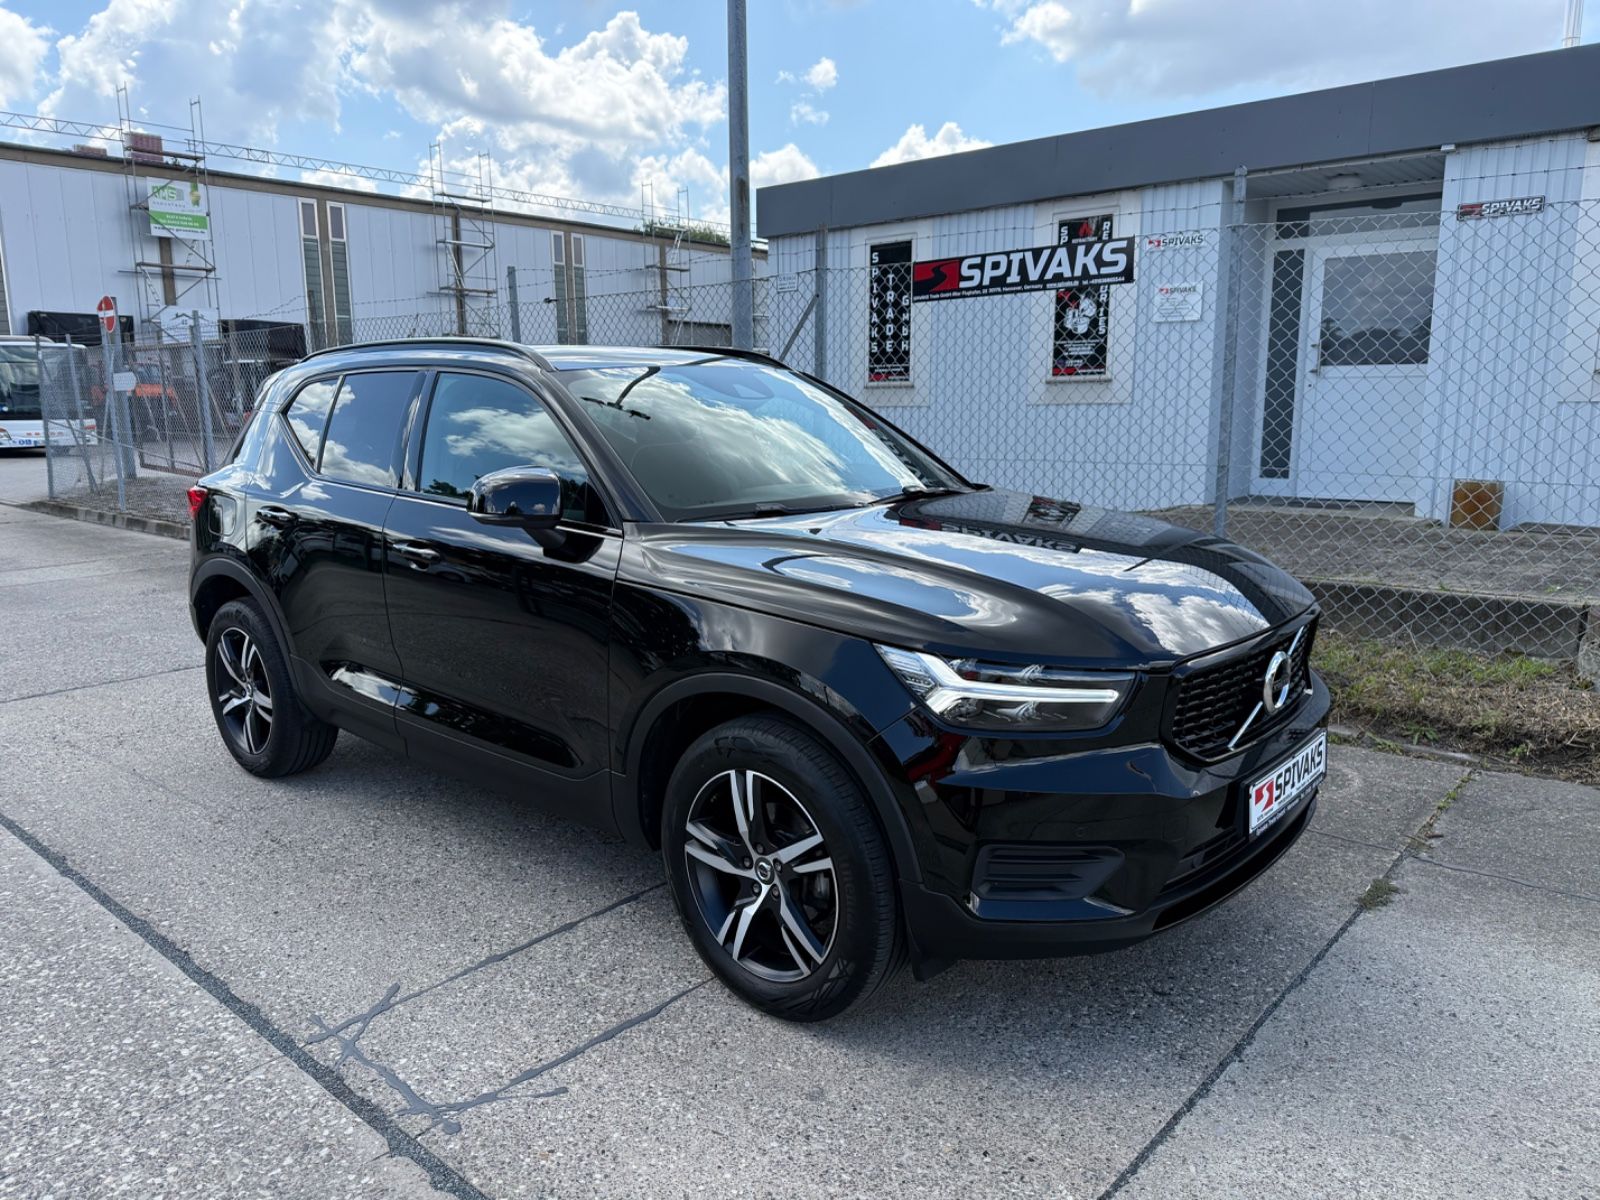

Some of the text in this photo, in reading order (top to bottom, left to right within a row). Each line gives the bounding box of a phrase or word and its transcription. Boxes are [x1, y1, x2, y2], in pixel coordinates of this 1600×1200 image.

[1481, 198, 1541, 214] SPIVAKS
[959, 240, 1127, 289] SPIVAKS
[1162, 234, 1203, 247] SPIVAKS
[871, 252, 880, 353] SPIVAKS
[886, 273, 896, 352] TRADE
[1275, 741, 1322, 802] SPIVAKS
